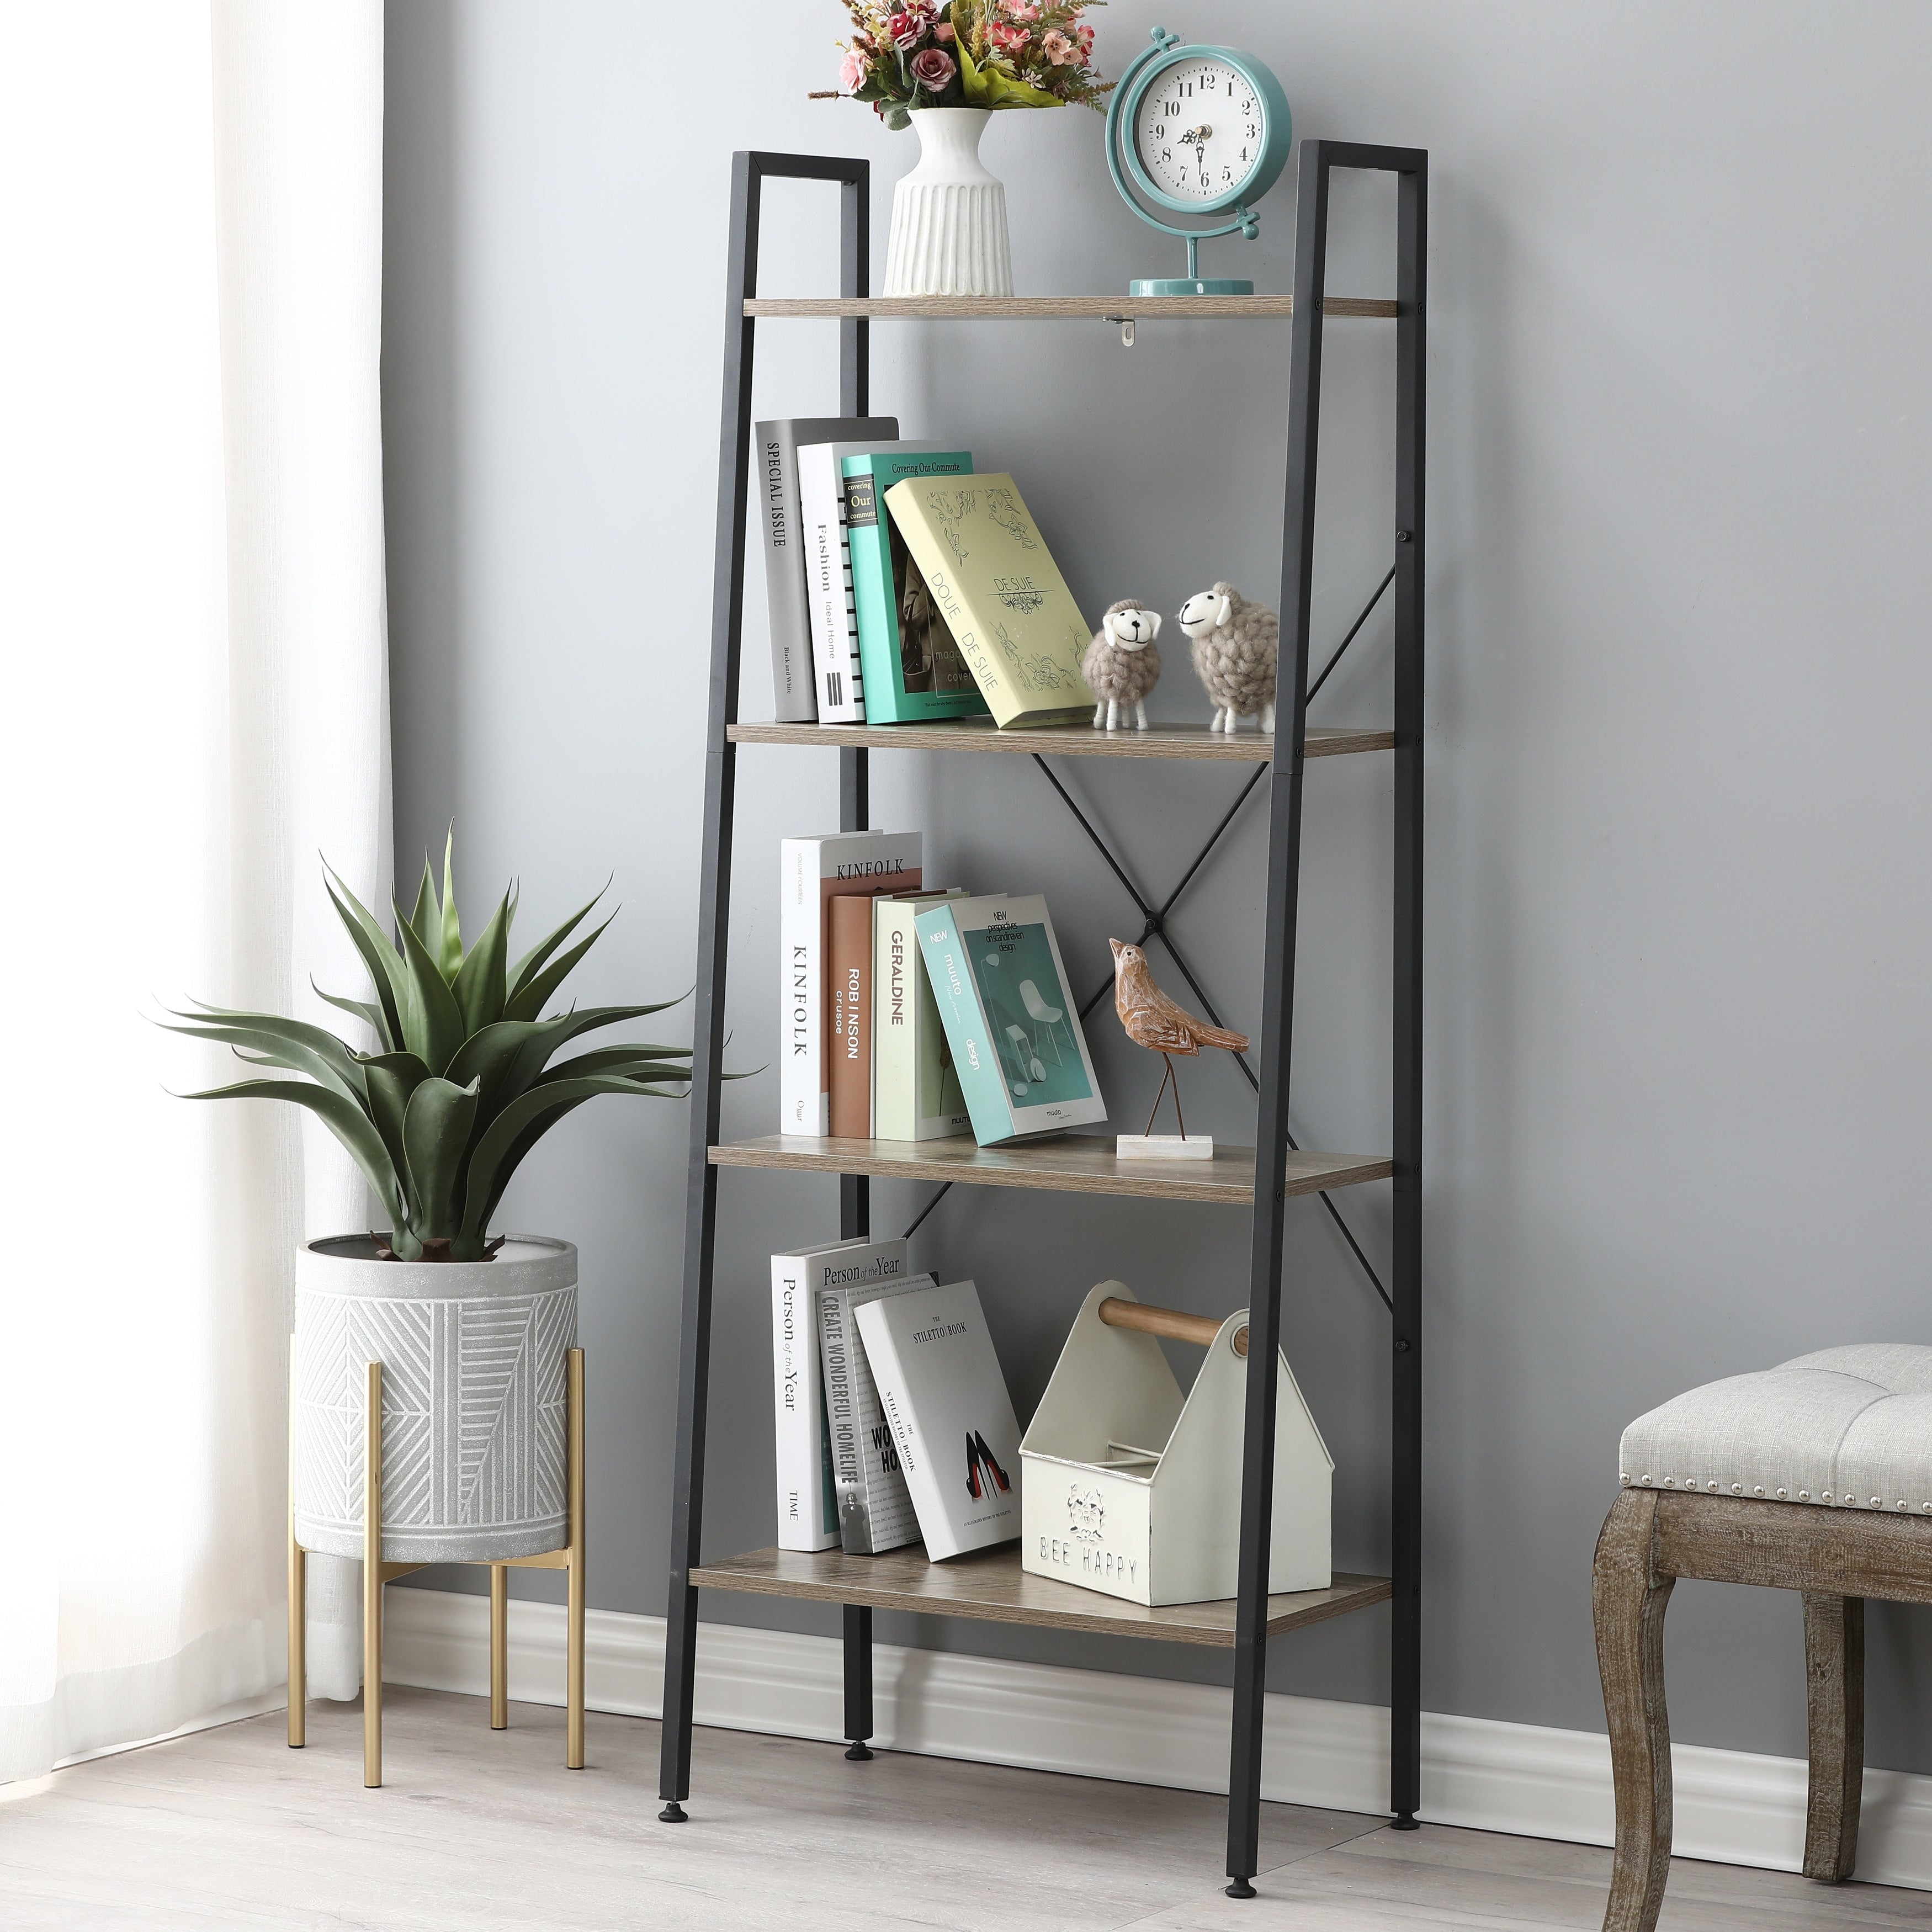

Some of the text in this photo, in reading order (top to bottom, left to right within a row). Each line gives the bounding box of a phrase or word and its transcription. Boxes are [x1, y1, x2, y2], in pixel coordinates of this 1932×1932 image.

[1177, 82, 1194, 97] 11
[1198, 75, 1216, 89] 12
[1227, 82, 1234, 97] 1
[1163, 101, 1180, 116] 10
[1242, 100, 1250, 115] 2
[1155, 124, 1165, 140] 9
[1246, 124, 1255, 139] 3
[1162, 147, 1171, 162] 8
[1239, 146, 1248, 161] 4
[1180, 166, 1188, 181] 7
[1201, 172, 1209, 187] 6
[1222, 166, 1231, 181] 5
[892, 462, 960, 475] Covering Our Commute
[847, 482, 872, 491] covering
[767, 443, 786, 547] SPECIAL ISSUE
[851, 496, 871, 507] Our
[850, 511, 876, 519] commute
[818, 524, 831, 591] Fashion
[825, 601, 834, 626] Ideal
[994, 577, 1036, 591] DE SUIE
[931, 572, 998, 692] DOUE DE SUIE
[837, 858, 904, 880] KINFOLK
[993, 911, 1006, 921] NEW
[988, 921, 1018, 934] perspectives
[930, 930, 948, 944] NEW
[999, 942, 1016, 953] design
[891, 930, 904, 1026] GERALDINE
[944, 953, 962, 995] muuto
[794, 945, 807, 1057] KINFOLK
[847, 968, 859, 1059] ROBINSON
[966, 1038, 980, 1071] design
[824, 1256, 900, 1286] Person of the Year
[913, 1321, 967, 1344] STILETTO BOOK
[783, 1277, 798, 1411] Person of the Year
[821, 1296, 858, 1484] CREATE WONDERFUL HOMELIFE
[885, 1391, 916, 1472] STILETTO BOOK
[789, 1490, 799, 1521] TIME
[1040, 1536, 1137, 1582] BEE HAPPY
